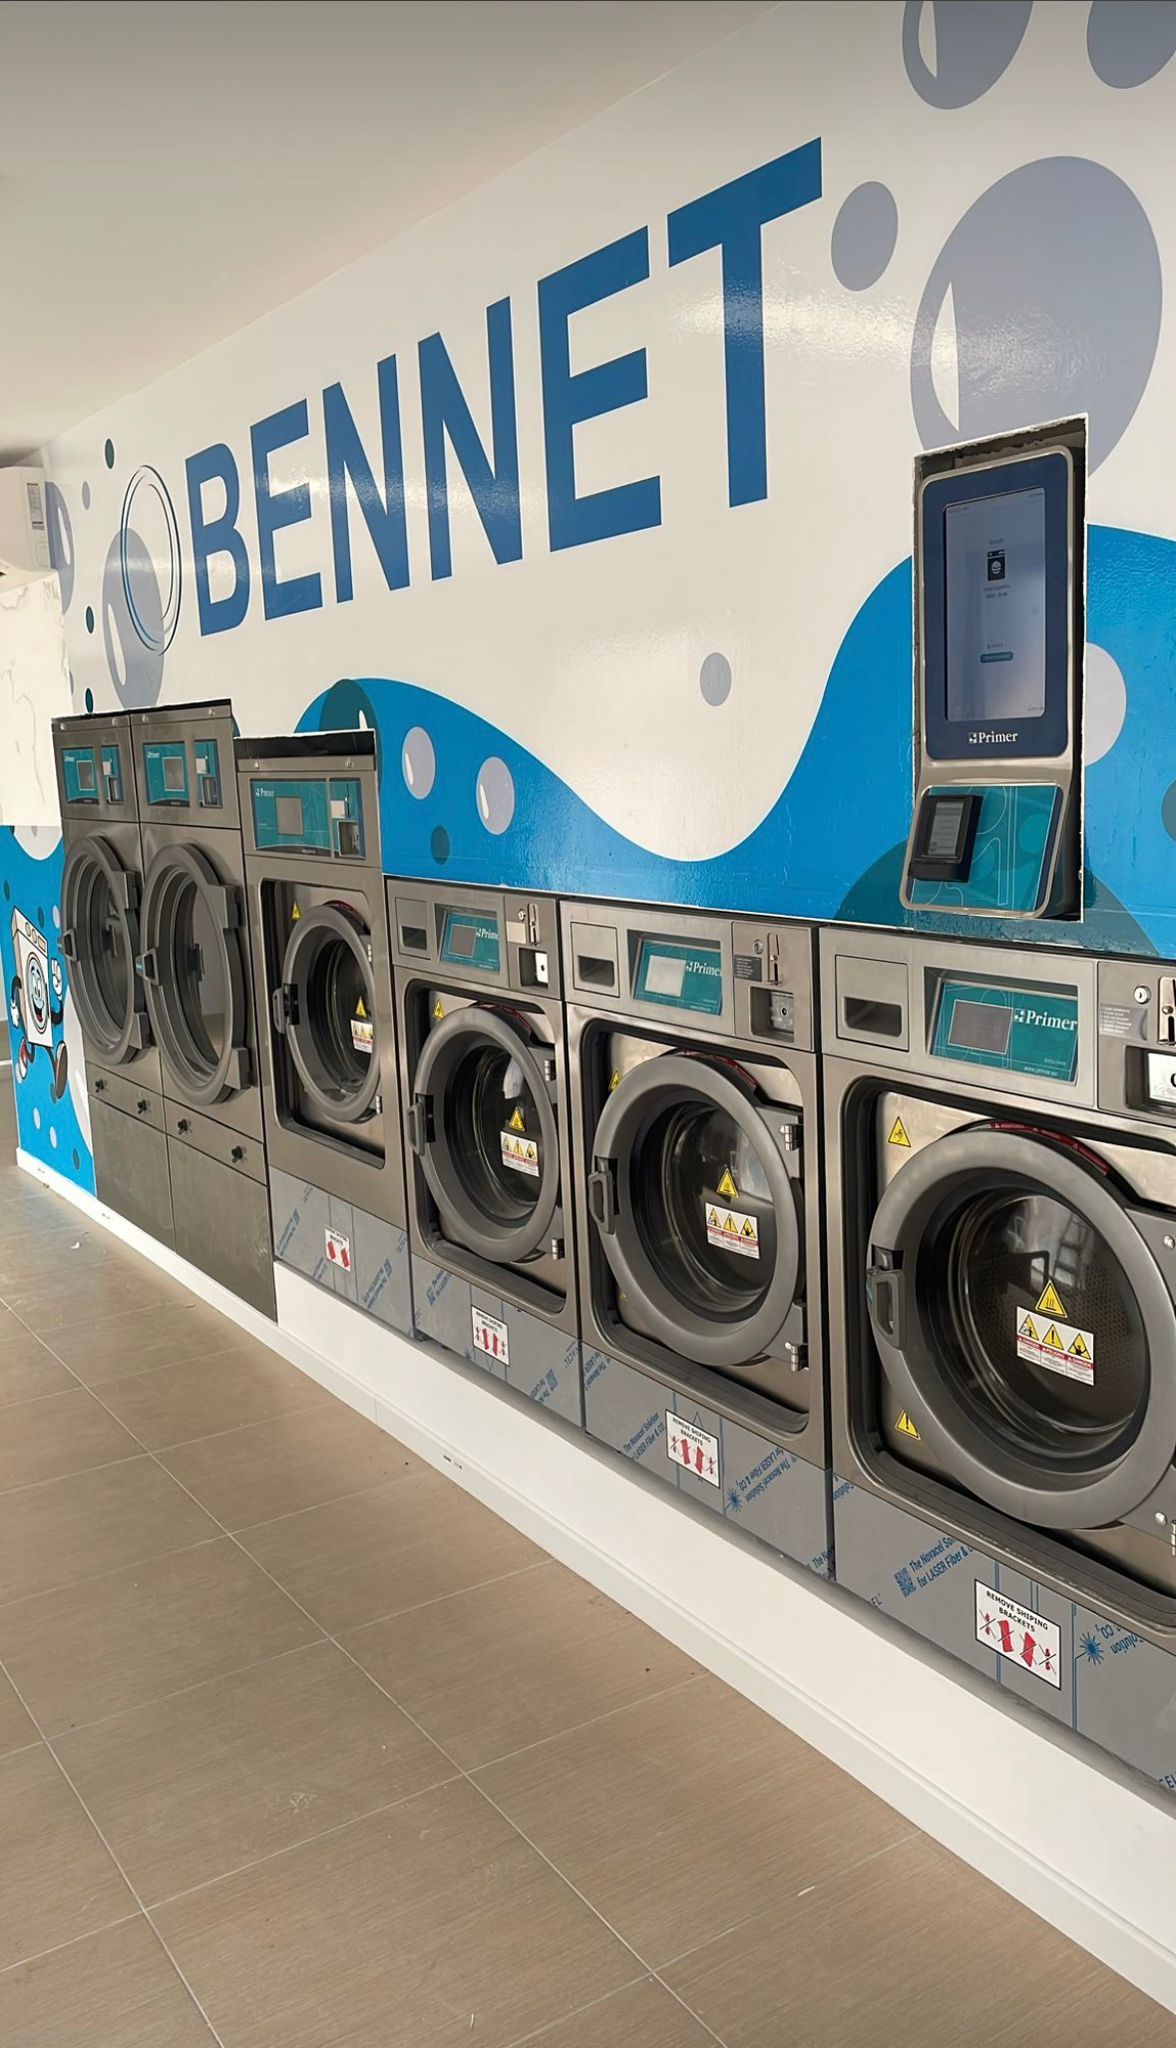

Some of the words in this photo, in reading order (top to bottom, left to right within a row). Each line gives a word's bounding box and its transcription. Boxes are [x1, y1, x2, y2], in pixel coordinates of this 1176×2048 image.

[186, 137, 822, 636] BENNET
[978, 730, 1019, 744] Primer
[693, 961, 722, 977] Prime
[1025, 1009, 1078, 1031] Primer
[909, 1560, 922, 1572] The
[920, 1540, 945, 1565] Novacel
[917, 1576, 928, 1588] for
[925, 1560, 948, 1582] LASER
[945, 1551, 962, 1568] Fiber
[960, 1546, 969, 1557] &
[986, 1590, 1015, 1611] REMOVE
[1016, 1607, 1048, 1630] SHIPING
[999, 1606, 1035, 1632] BRACKETS
